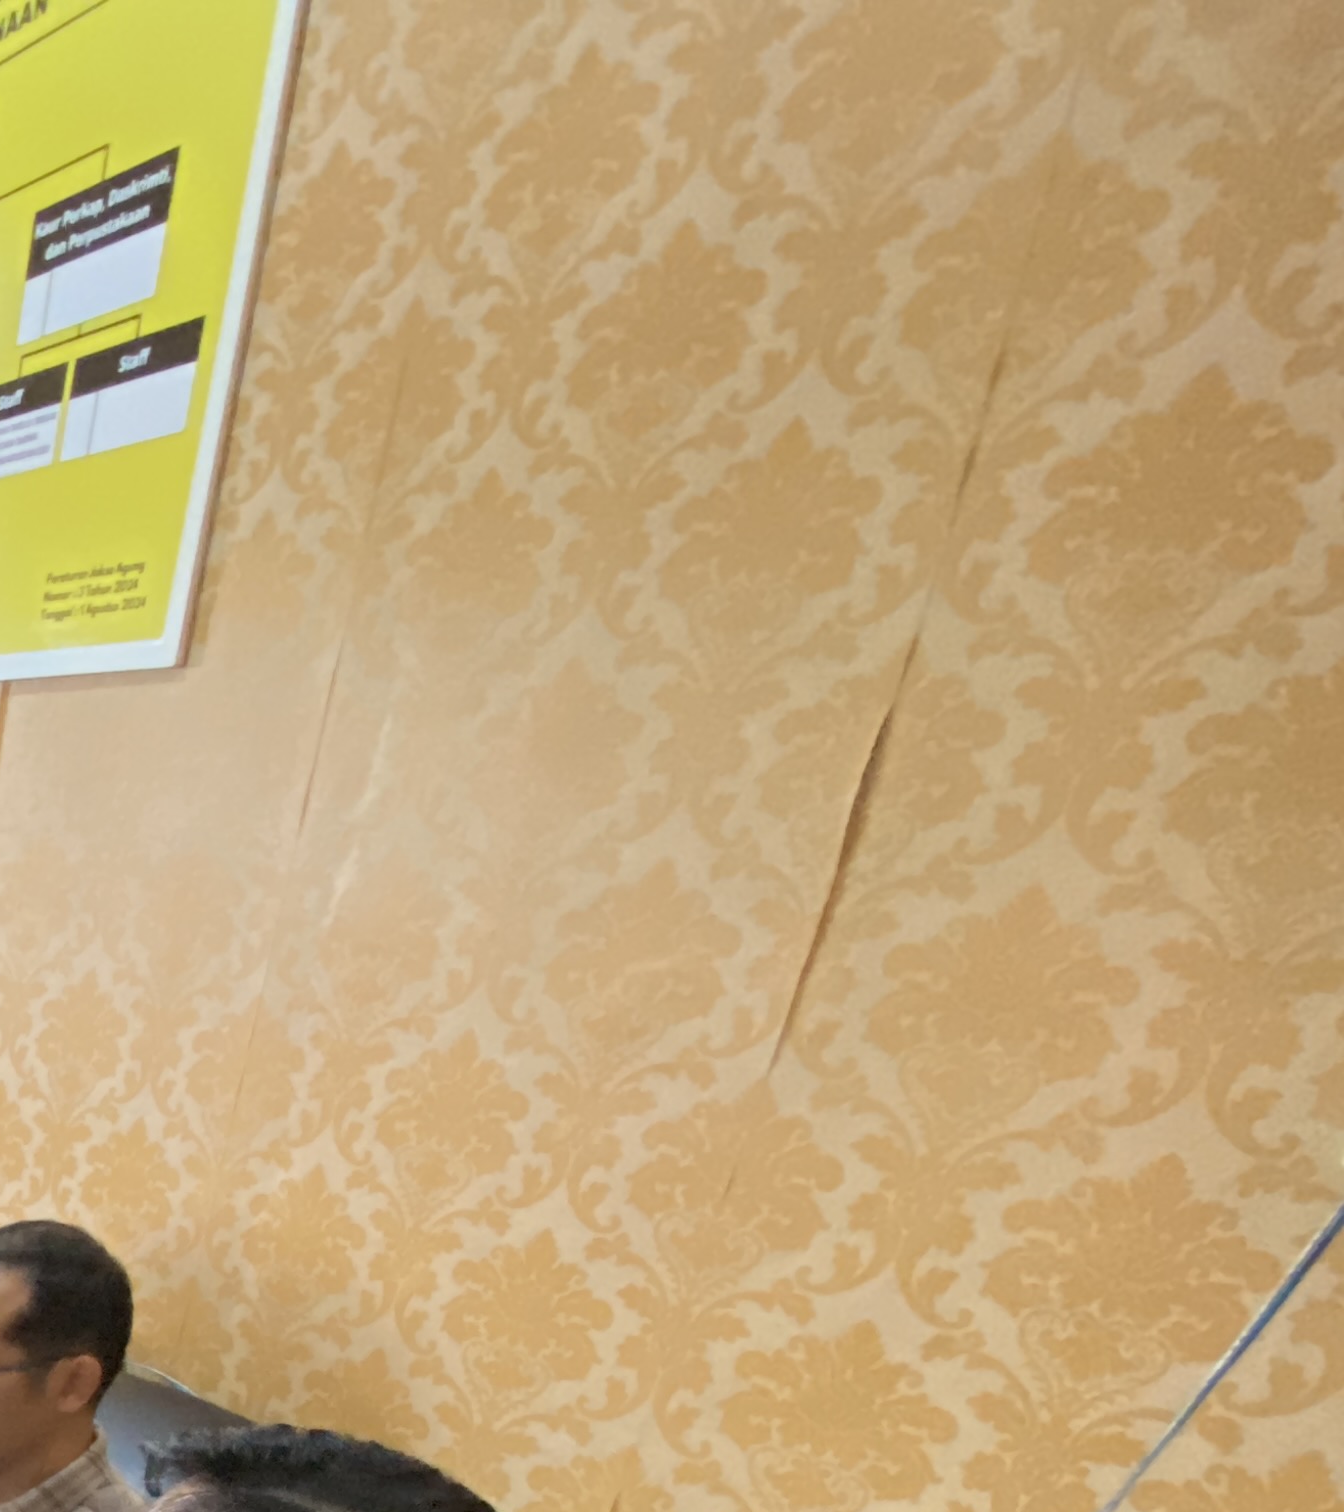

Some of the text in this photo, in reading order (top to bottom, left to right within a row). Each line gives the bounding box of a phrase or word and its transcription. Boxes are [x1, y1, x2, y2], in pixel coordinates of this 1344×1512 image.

[44, 204, 151, 261] dan Perpustakaan
[117, 346, 153, 374] Staff
